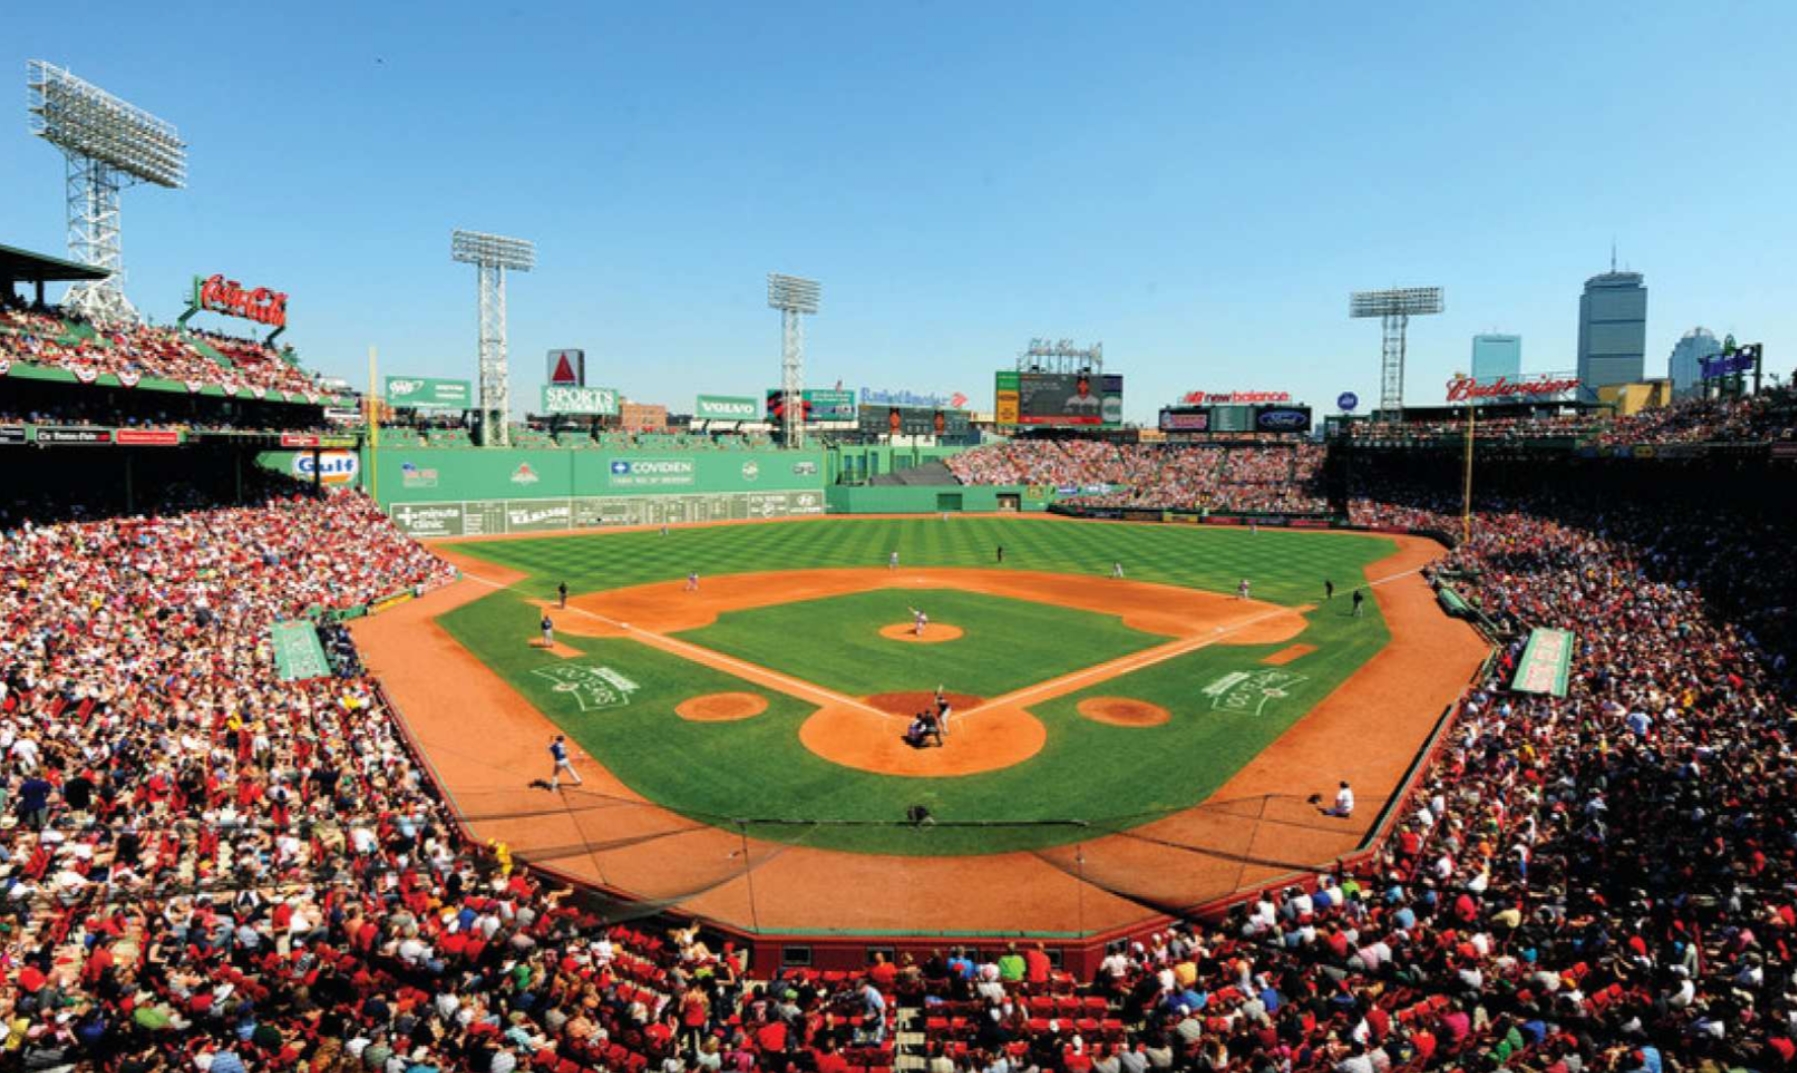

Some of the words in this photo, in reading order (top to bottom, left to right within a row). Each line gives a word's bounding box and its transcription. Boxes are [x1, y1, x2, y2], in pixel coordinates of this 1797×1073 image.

[1446, 375, 1582, 402] Budweiser
[546, 387, 613, 405] SPORTS
[1205, 394, 1231, 403] new
[1232, 390, 1289, 403] balance
[701, 402, 755, 414] VOLVO
[298, 458, 354, 472] Gulf
[631, 461, 692, 474] COVIDIEN
